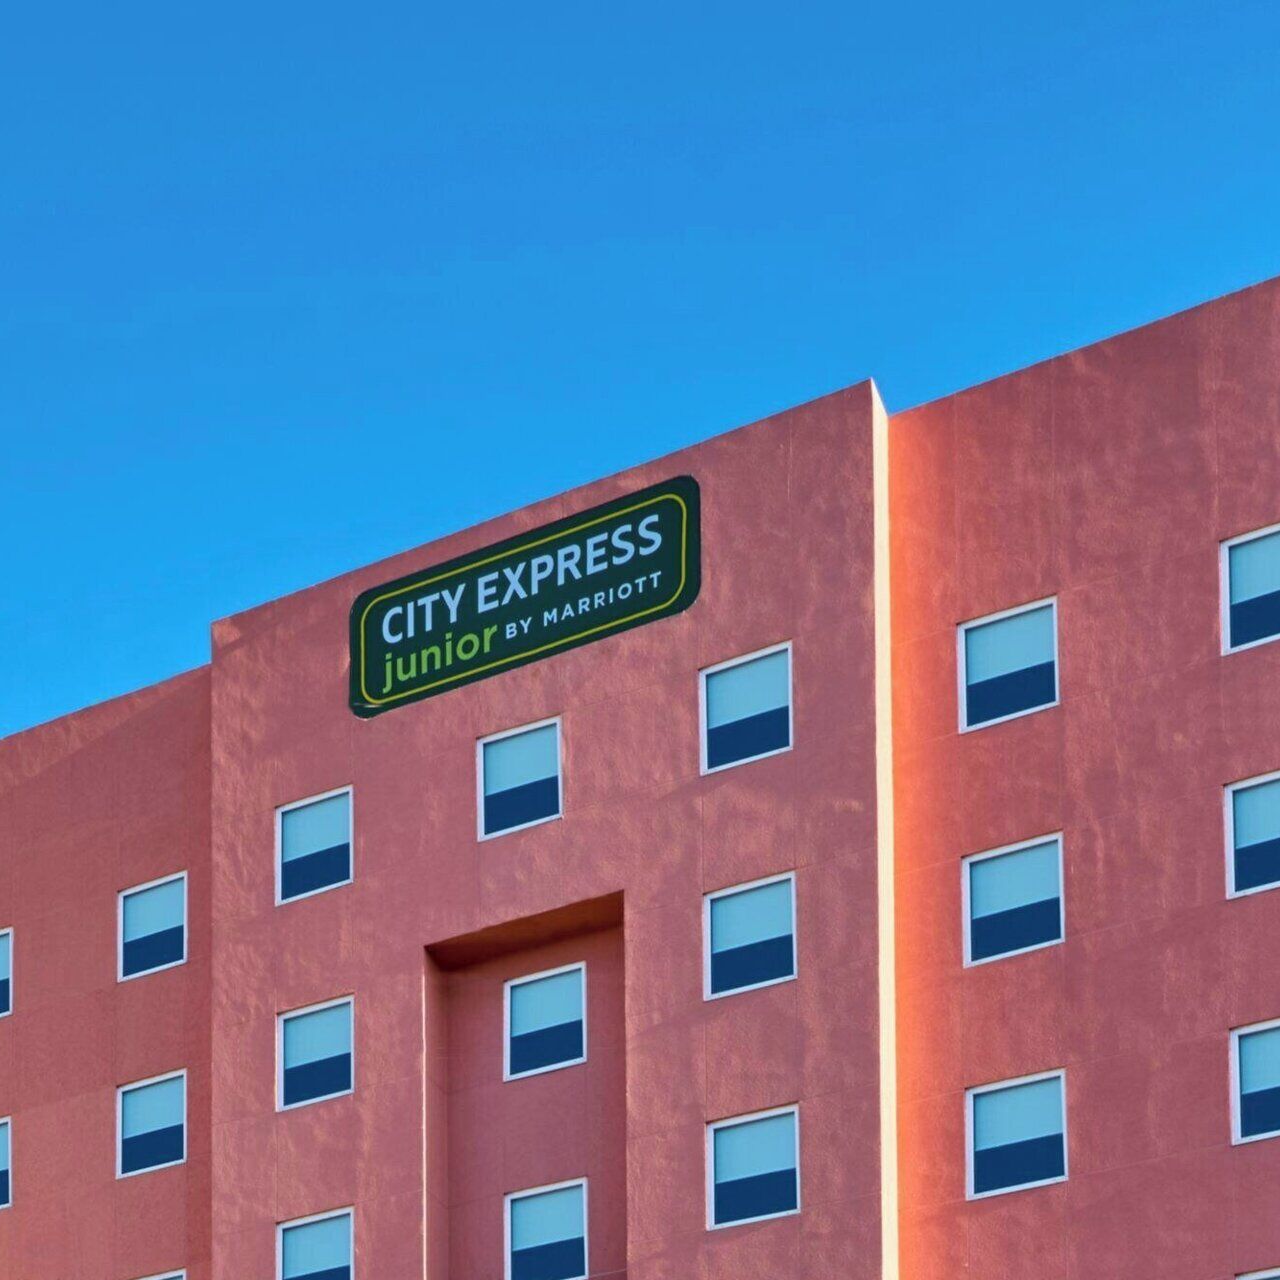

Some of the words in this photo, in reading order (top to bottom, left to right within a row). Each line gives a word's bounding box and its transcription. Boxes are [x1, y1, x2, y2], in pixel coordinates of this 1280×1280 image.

[381, 624, 498, 694] junior
[505, 617, 532, 640] BY
[543, 571, 663, 627] MARRIOTT
[382, 583, 466, 644] CITY
[477, 513, 663, 614] EXPRESS
